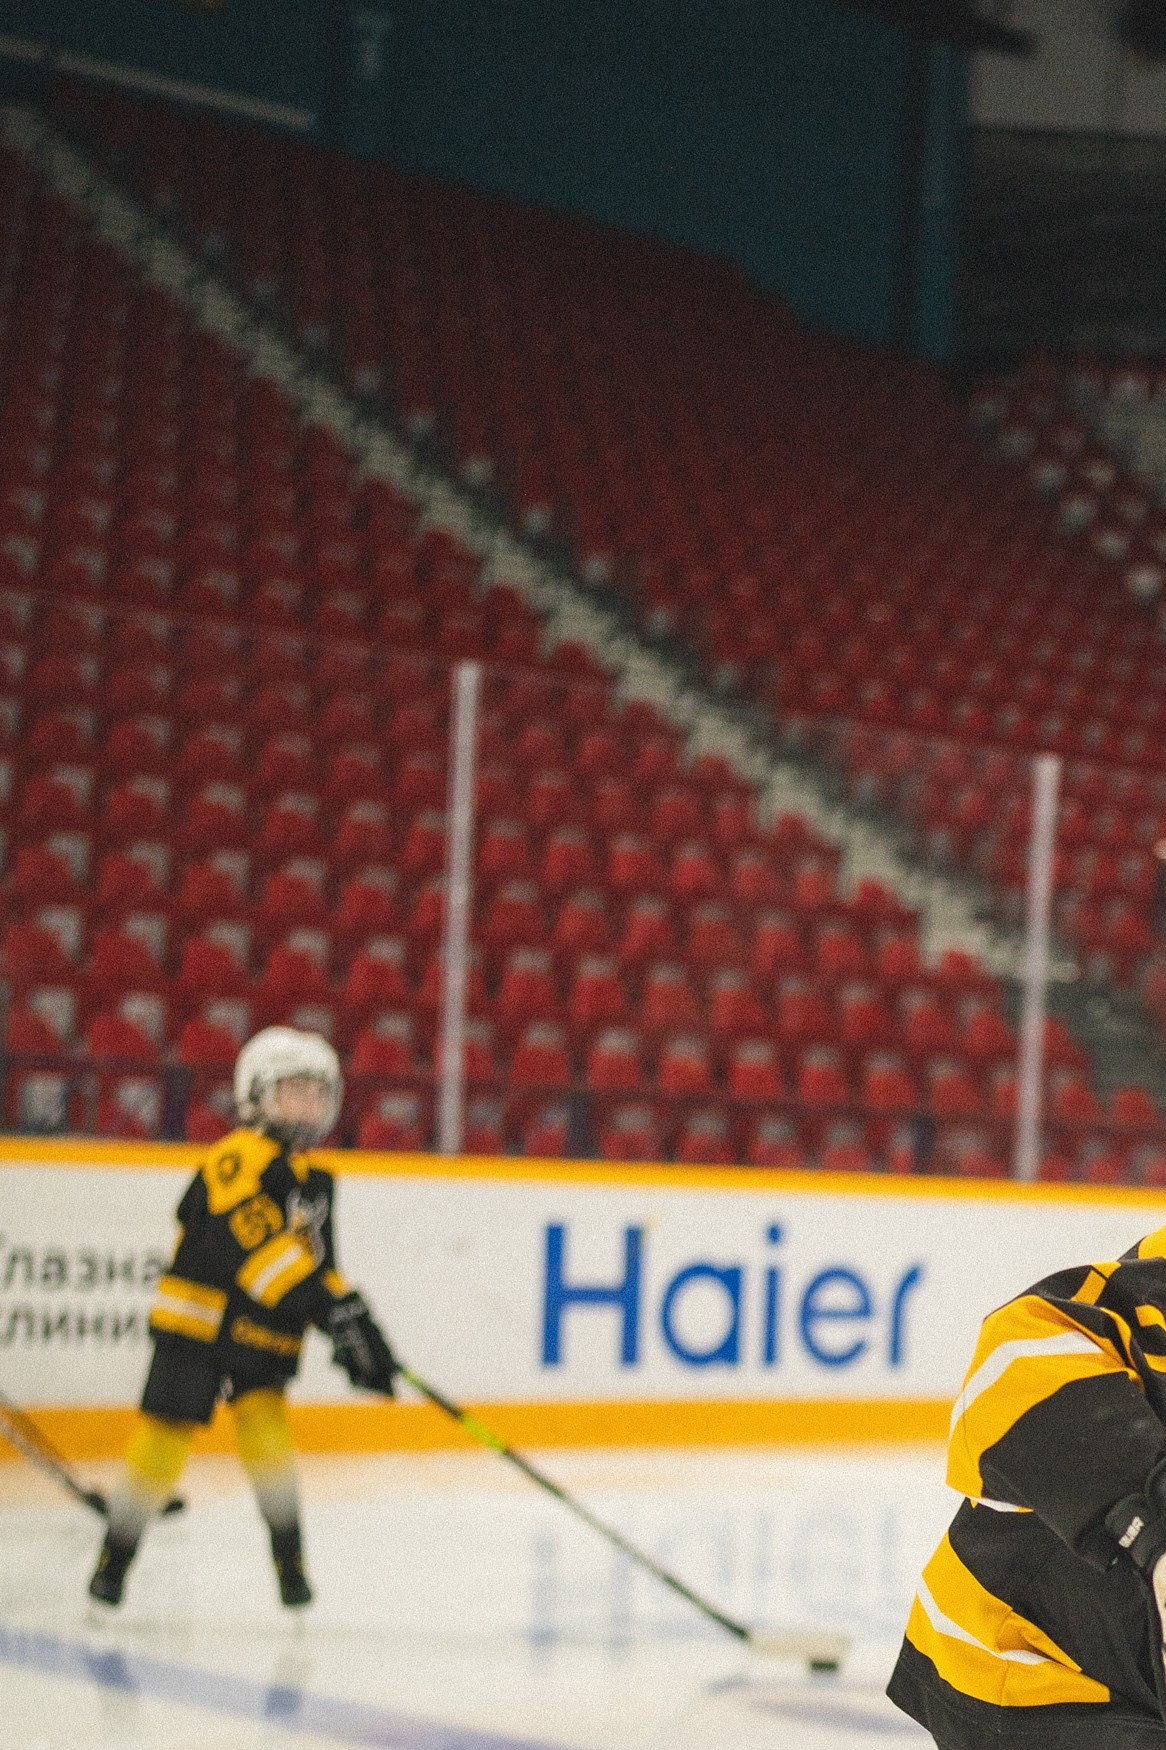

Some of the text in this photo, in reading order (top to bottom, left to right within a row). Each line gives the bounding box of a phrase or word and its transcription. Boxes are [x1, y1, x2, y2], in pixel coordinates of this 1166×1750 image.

[0, 1240, 168, 1291] лазна
[540, 1219, 924, 1370] Haier
[0, 1306, 142, 1346] лини
